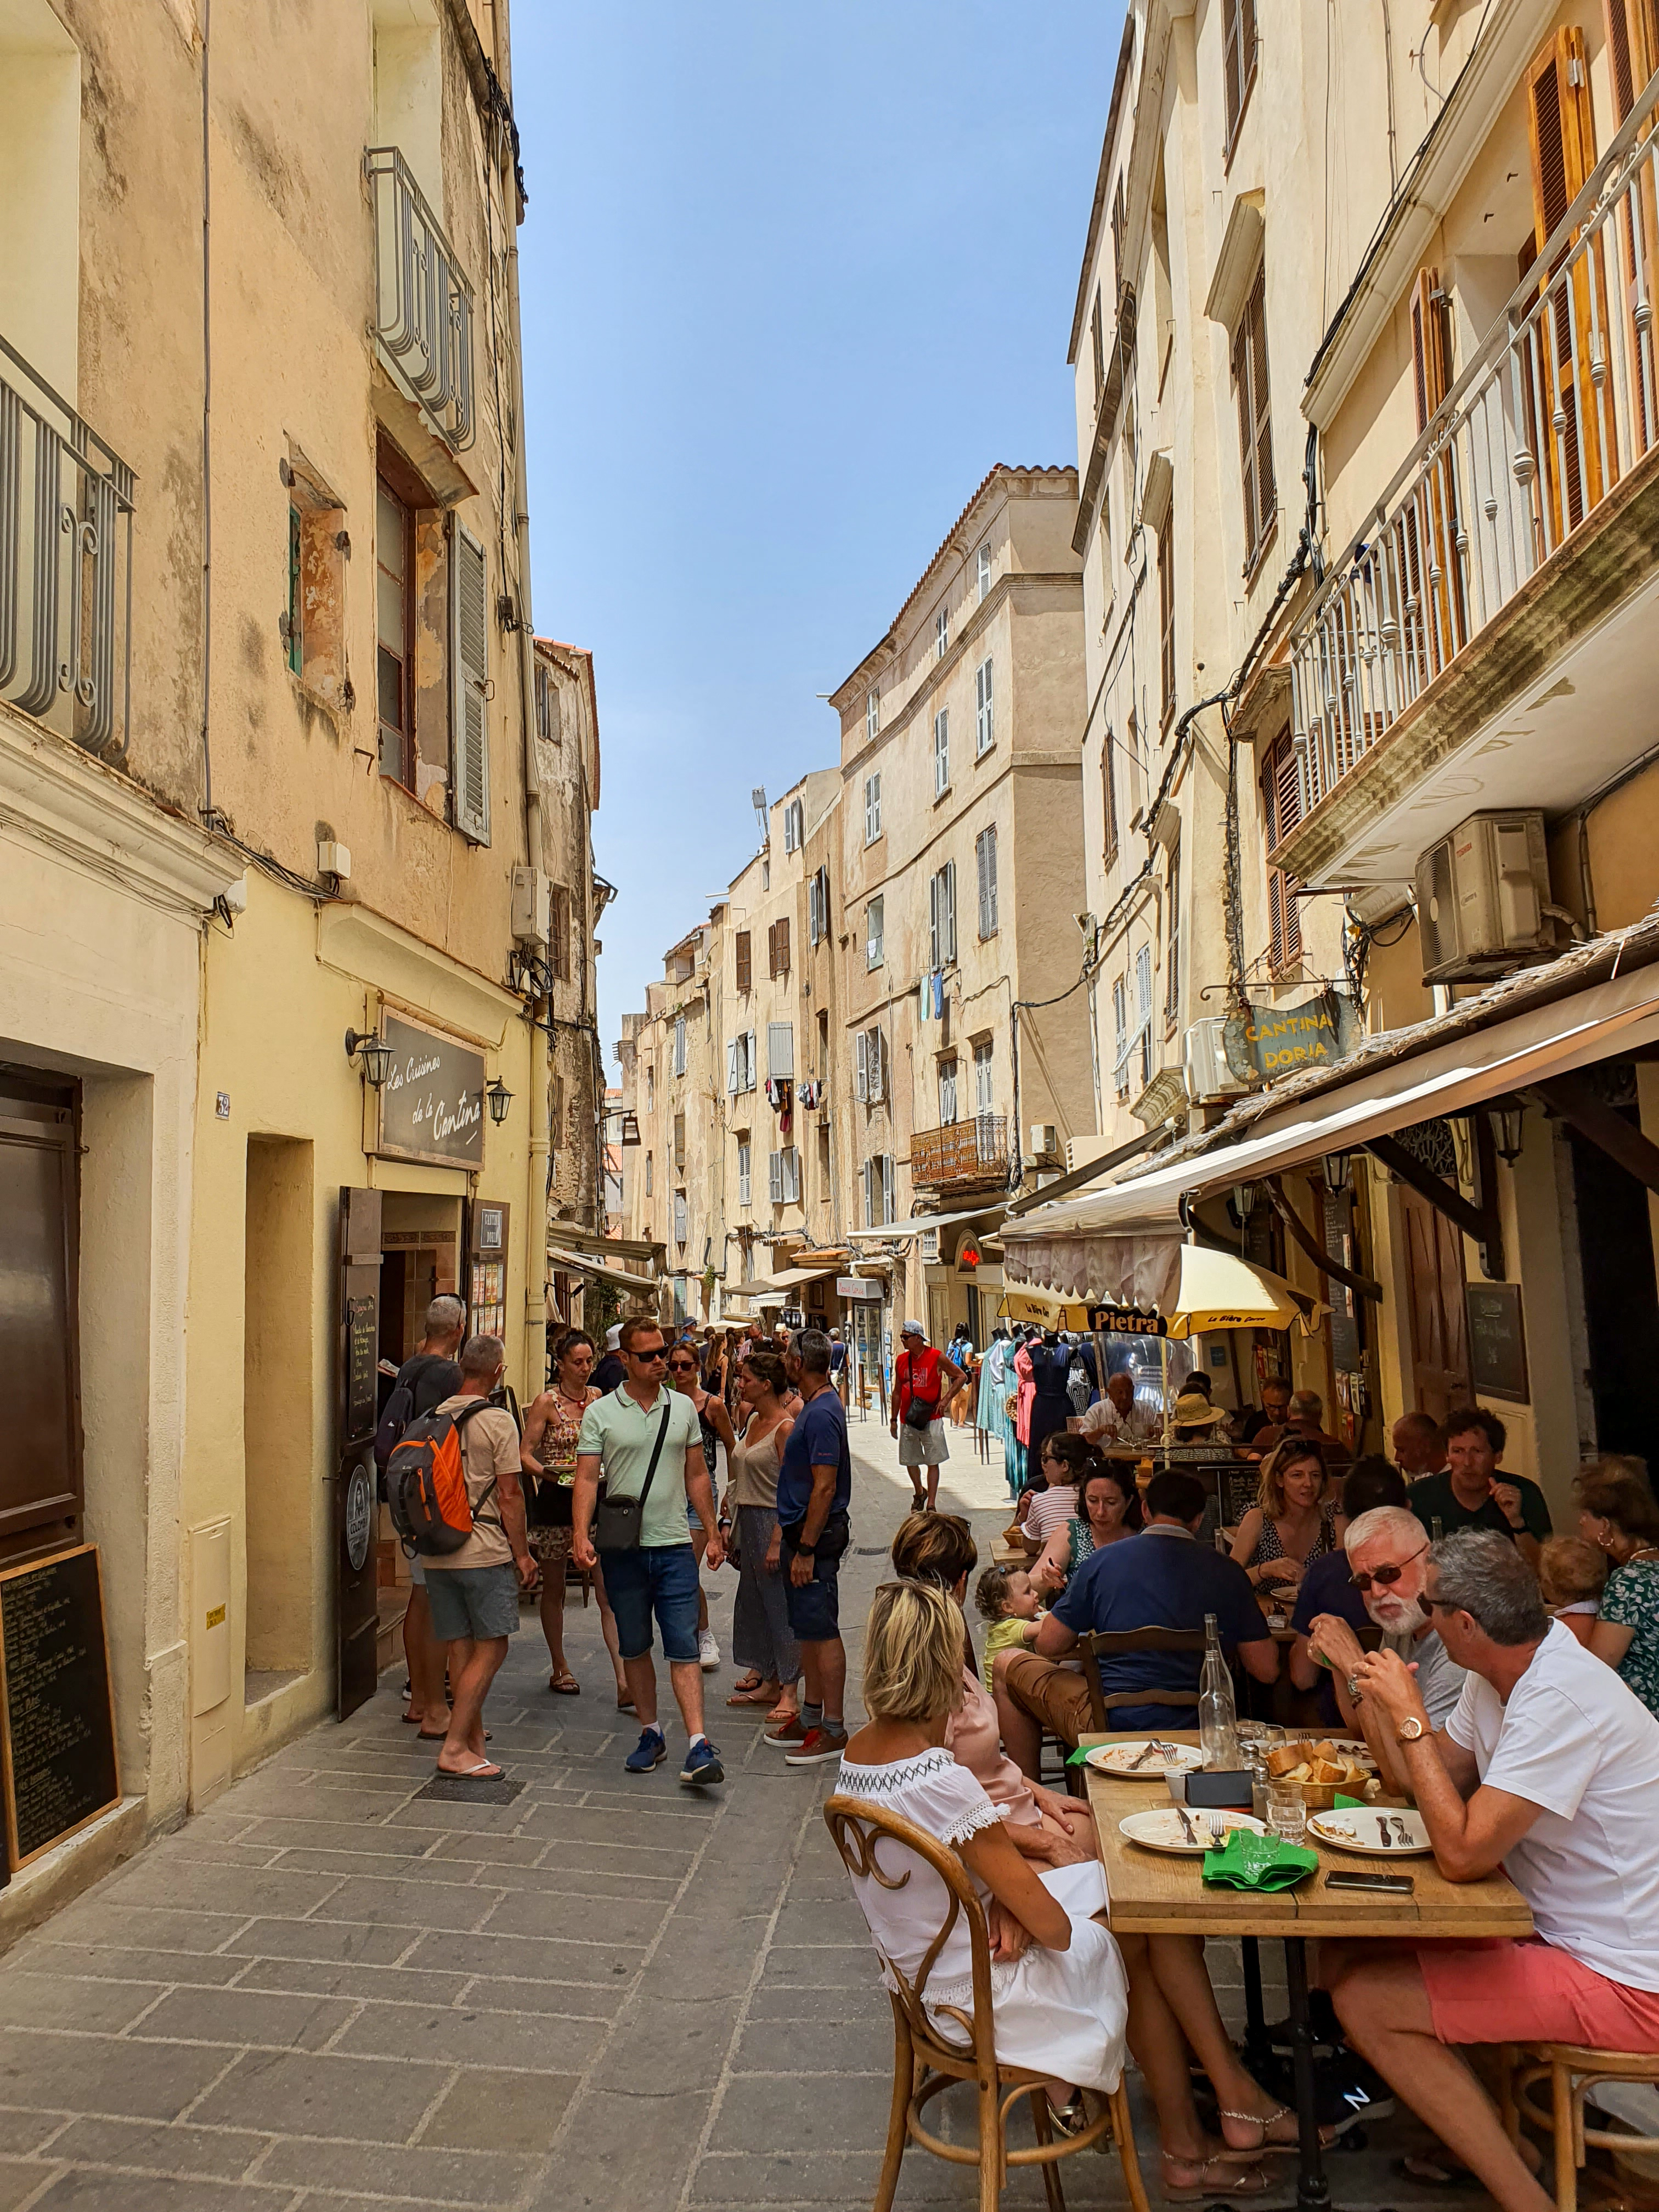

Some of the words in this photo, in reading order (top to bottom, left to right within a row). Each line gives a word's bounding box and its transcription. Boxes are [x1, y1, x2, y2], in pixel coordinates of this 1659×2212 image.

[1245, 1014, 1333, 1041] CANTINA
[1265, 1042, 1328, 1068] DORIA
[387, 1064, 404, 1091] Les
[407, 1054, 441, 1083] Cuisines
[218, 1096, 229, 1115] 32
[413, 1097, 423, 1125] de
[426, 1092, 433, 1119] la
[433, 1090, 481, 1141] Cantina
[1095, 1311, 1159, 1334] Pietra
